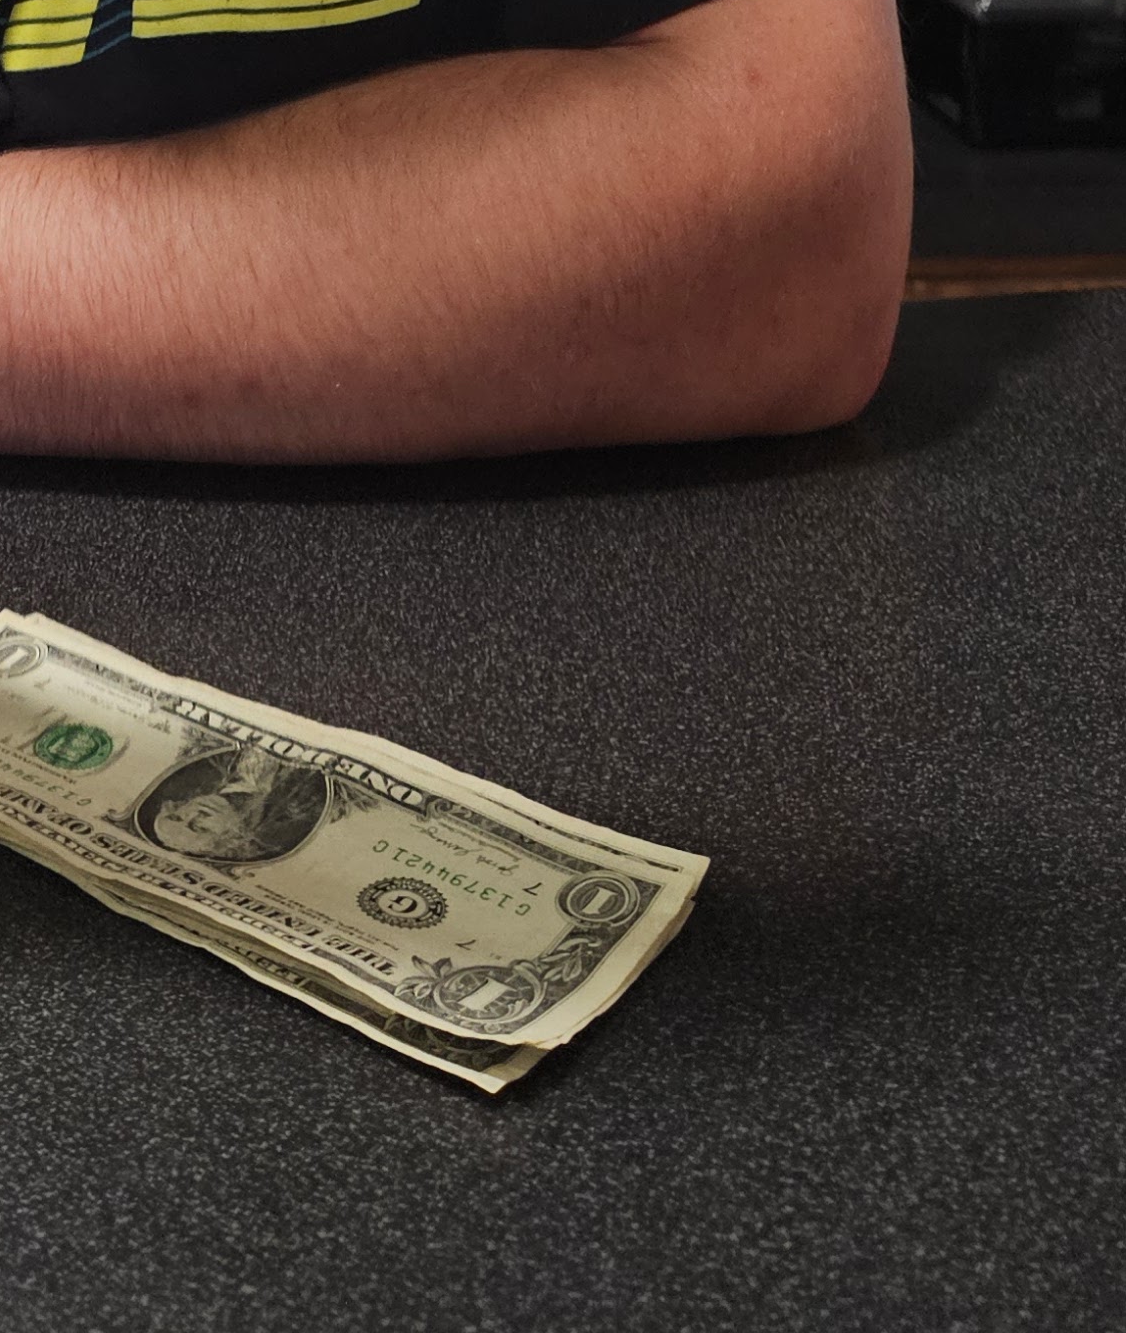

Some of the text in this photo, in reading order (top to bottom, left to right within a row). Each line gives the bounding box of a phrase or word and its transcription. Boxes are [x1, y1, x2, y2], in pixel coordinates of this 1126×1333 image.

[175, 699, 332, 766] DOLLAR
[334, 757, 424, 807] ONE
[48, 810, 94, 835] OF
[90, 833, 206, 885] STATES
[202, 880, 323, 937] UNITED
[324, 935, 398, 975] THE
